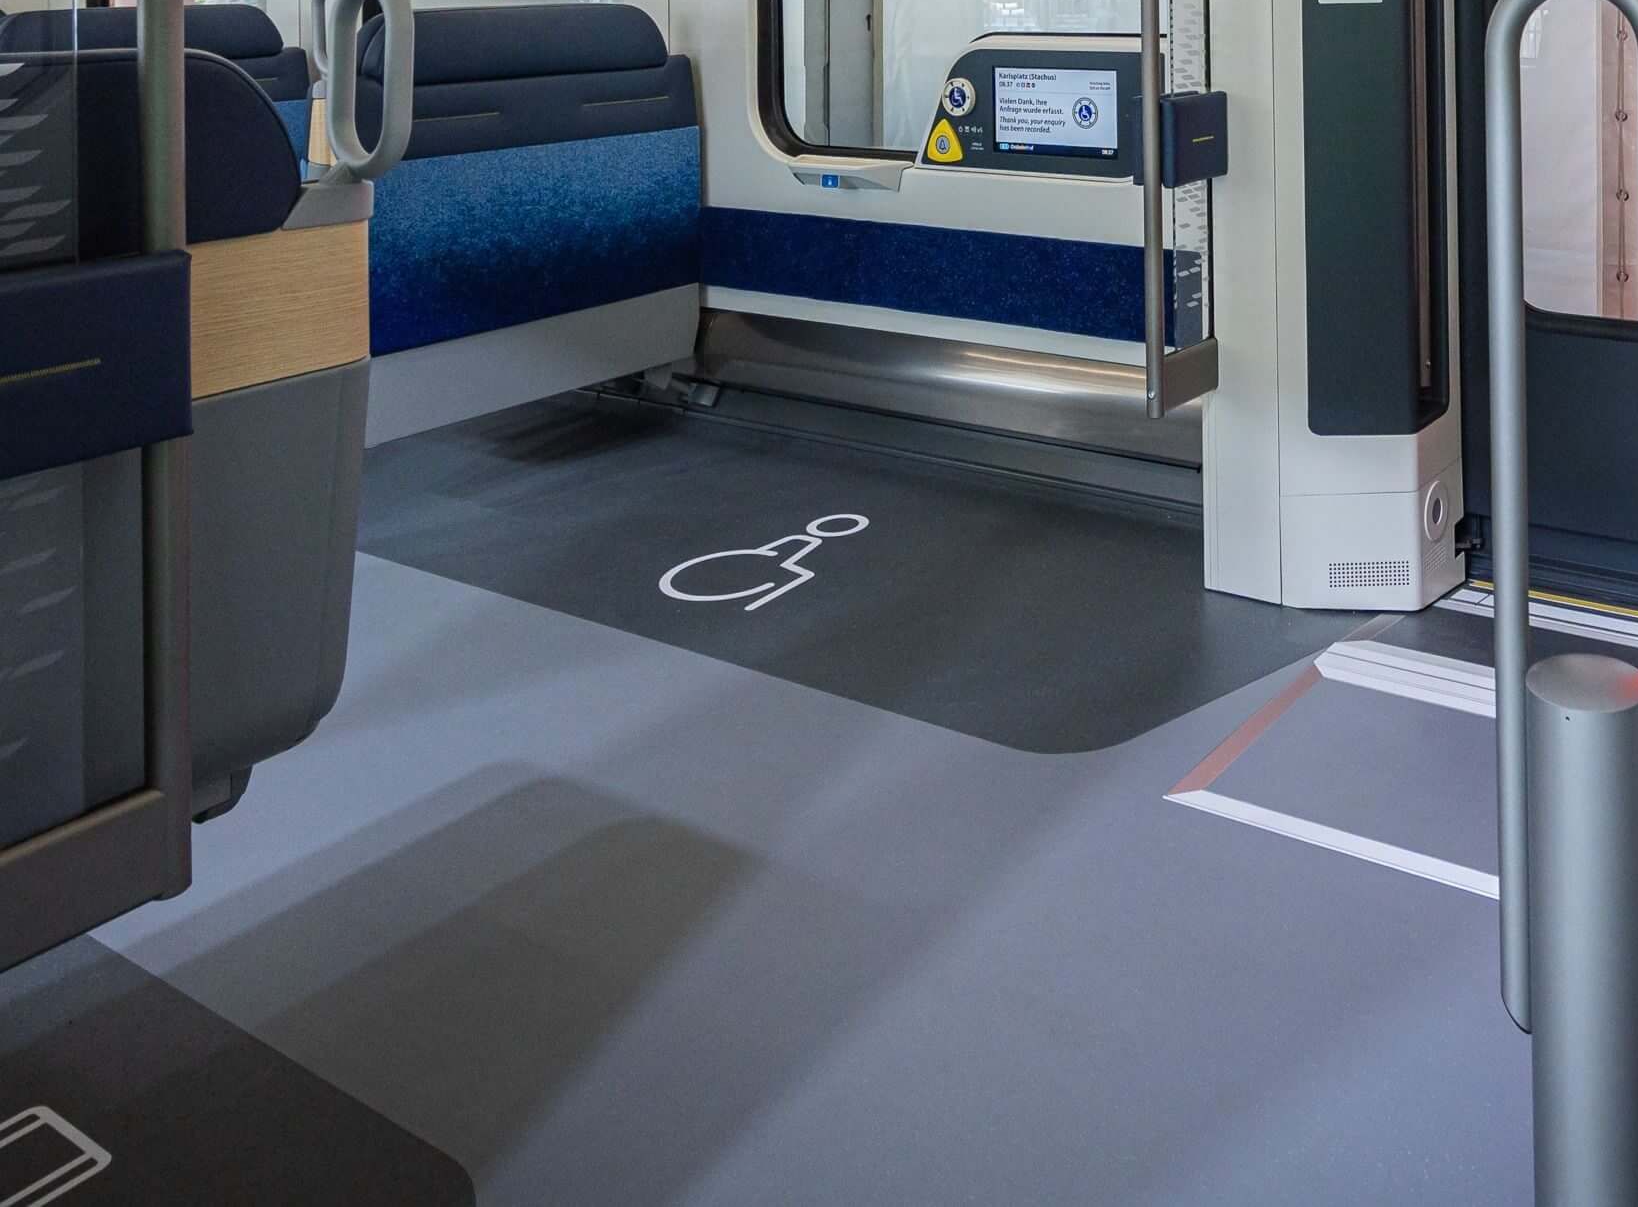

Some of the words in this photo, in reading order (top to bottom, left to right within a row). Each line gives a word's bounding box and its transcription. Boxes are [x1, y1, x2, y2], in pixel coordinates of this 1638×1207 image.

[999, 72, 1028, 81] Karlsplatz
[1029, 73, 1057, 81] (Stachus)
[1018, 98, 1035, 106] Dank,
[999, 107, 1022, 115] Anfrage
[1010, 124, 1024, 132] been
